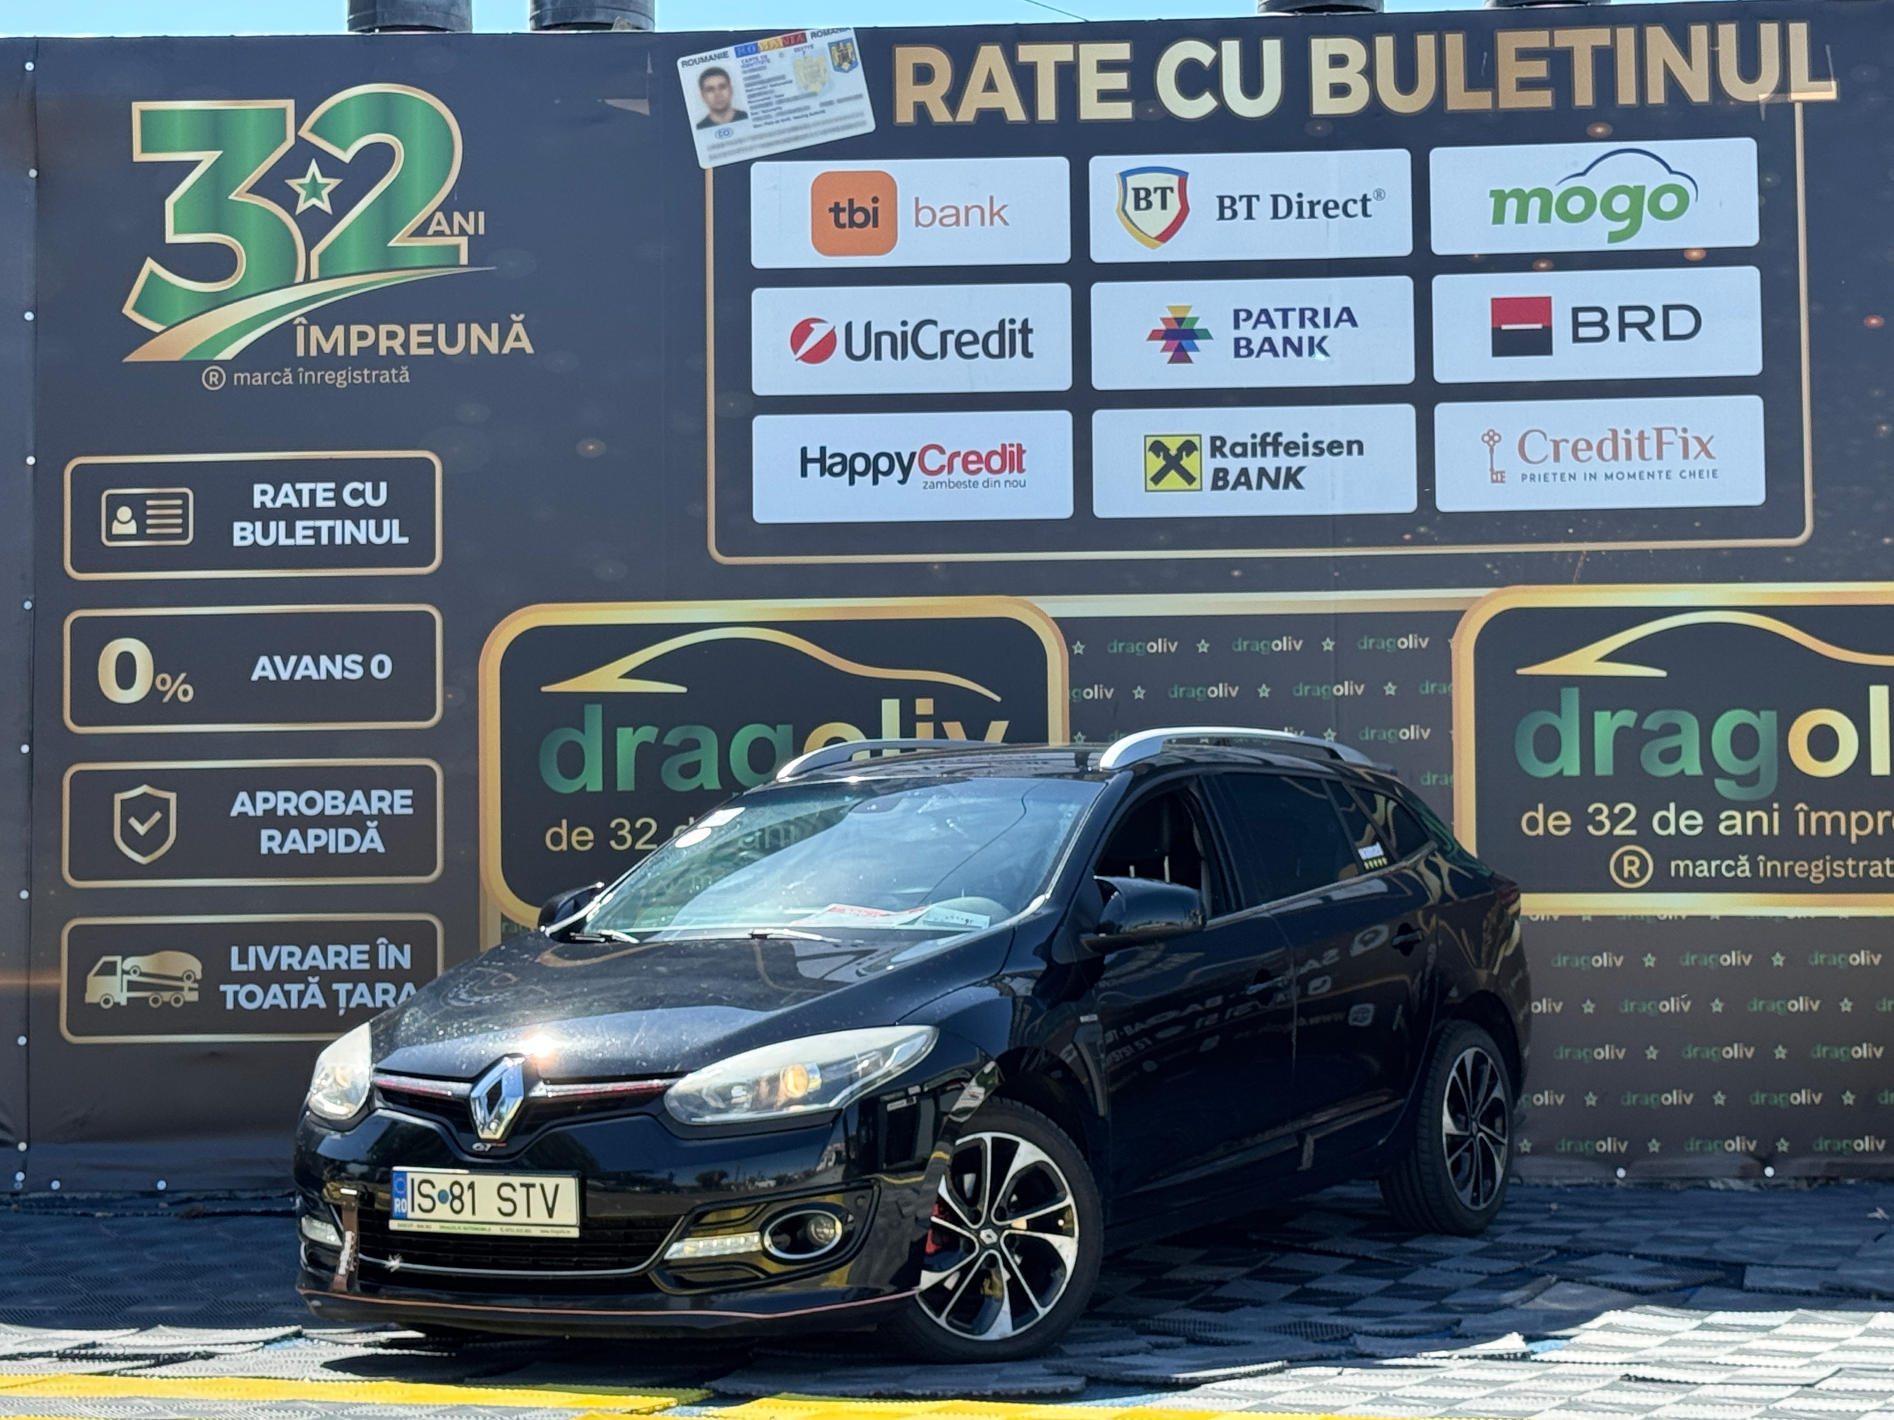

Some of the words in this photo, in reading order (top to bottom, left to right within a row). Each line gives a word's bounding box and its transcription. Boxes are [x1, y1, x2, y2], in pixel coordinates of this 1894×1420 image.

[895, 43, 1134, 124] RATE
[1155, 39, 1284, 119] CU
[1309, 22, 1838, 115] BULETINUL
[122, 83, 468, 334] 32
[828, 196, 880, 229] tbi
[914, 196, 1010, 228] bank
[1131, 186, 1174, 212] BT
[1216, 194, 1260, 221] BT
[427, 211, 486, 236] ANI
[1488, 182, 1691, 244] mogo
[1233, 306, 1359, 331] PATRIA
[1571, 304, 1702, 344] BRD
[293, 313, 534, 357] ÎMPREUNĂ
[844, 317, 1035, 362] UniCredit
[1233, 335, 1331, 360] BANK
[233, 367, 293, 387] marcă
[298, 365, 411, 388] înregistrată
[1210, 432, 1364, 459] Raiffeisen
[1518, 427, 1717, 464] CreditFix
[801, 443, 1027, 486] HappyCredit
[1521, 472, 1577, 483] PRIETEN
[1584, 471, 1598, 481] IN
[1604, 470, 1673, 481] MOMENTE
[1679, 469, 1719, 479] CHEIE
[922, 478, 979, 490] zambeste
[982, 477, 1000, 489] din
[1004, 479, 1027, 489] nou
[1210, 466, 1308, 491] BANK
[253, 481, 337, 508] RATE
[342, 481, 388, 508] CU
[232, 519, 409, 547] BULETINUL
[1107, 638, 1179, 656] dragoliv
[1231, 636, 1303, 655] dragoliv
[1357, 634, 1430, 653] dragoliv
[251, 655, 364, 681] AVANS
[369, 653, 393, 680] 0
[1168, 682, 1239, 701] dragoliv
[1293, 681, 1365, 699] dragoliv
[538, 697, 1010, 794] dragli
[1359, 725, 1431, 743] dragoliv
[1514, 685, 1891, 801] dragol
[230, 788, 414, 817] APROBARE
[260, 820, 386, 854] RAPIDĂ
[545, 818, 595, 852] de
[610, 817, 657, 851] 32
[1521, 803, 1572, 837] de
[1587, 803, 1638, 836] 32
[1652, 802, 1704, 836] de
[1718, 803, 1780, 836] ani
[1793, 802, 1894, 845] împr
[1670, 855, 1752, 878] marcă
[231, 944, 370, 971] LIVRARE
[376, 937, 411, 970] ÎN
[1551, 951, 1624, 969] dragoliv
[1679, 950, 1753, 968] dragoliv
[1808, 949, 1882, 968] dragoliv
[219, 976, 327, 1010] TOATĂ
[1619, 997, 1691, 1016] dragoliv
[1747, 996, 1821, 1014] dragoliv
[1553, 1044, 1626, 1063] dragoliv
[1682, 1043, 1755, 1061] dragoliv
[1810, 1042, 1884, 1061] dragoliv
[1620, 1089, 1694, 1108] dragoliv
[1749, 1088, 1823, 1107] dragoliv
[1555, 1136, 1628, 1155] dragoliv
[1684, 1136, 1758, 1154] dragoliv
[1812, 1135, 1886, 1154] dragoliv
[394, 1198, 407, 1213] RO
[450, 1180, 476, 1216] 81
[497, 1182, 560, 1219] STV
